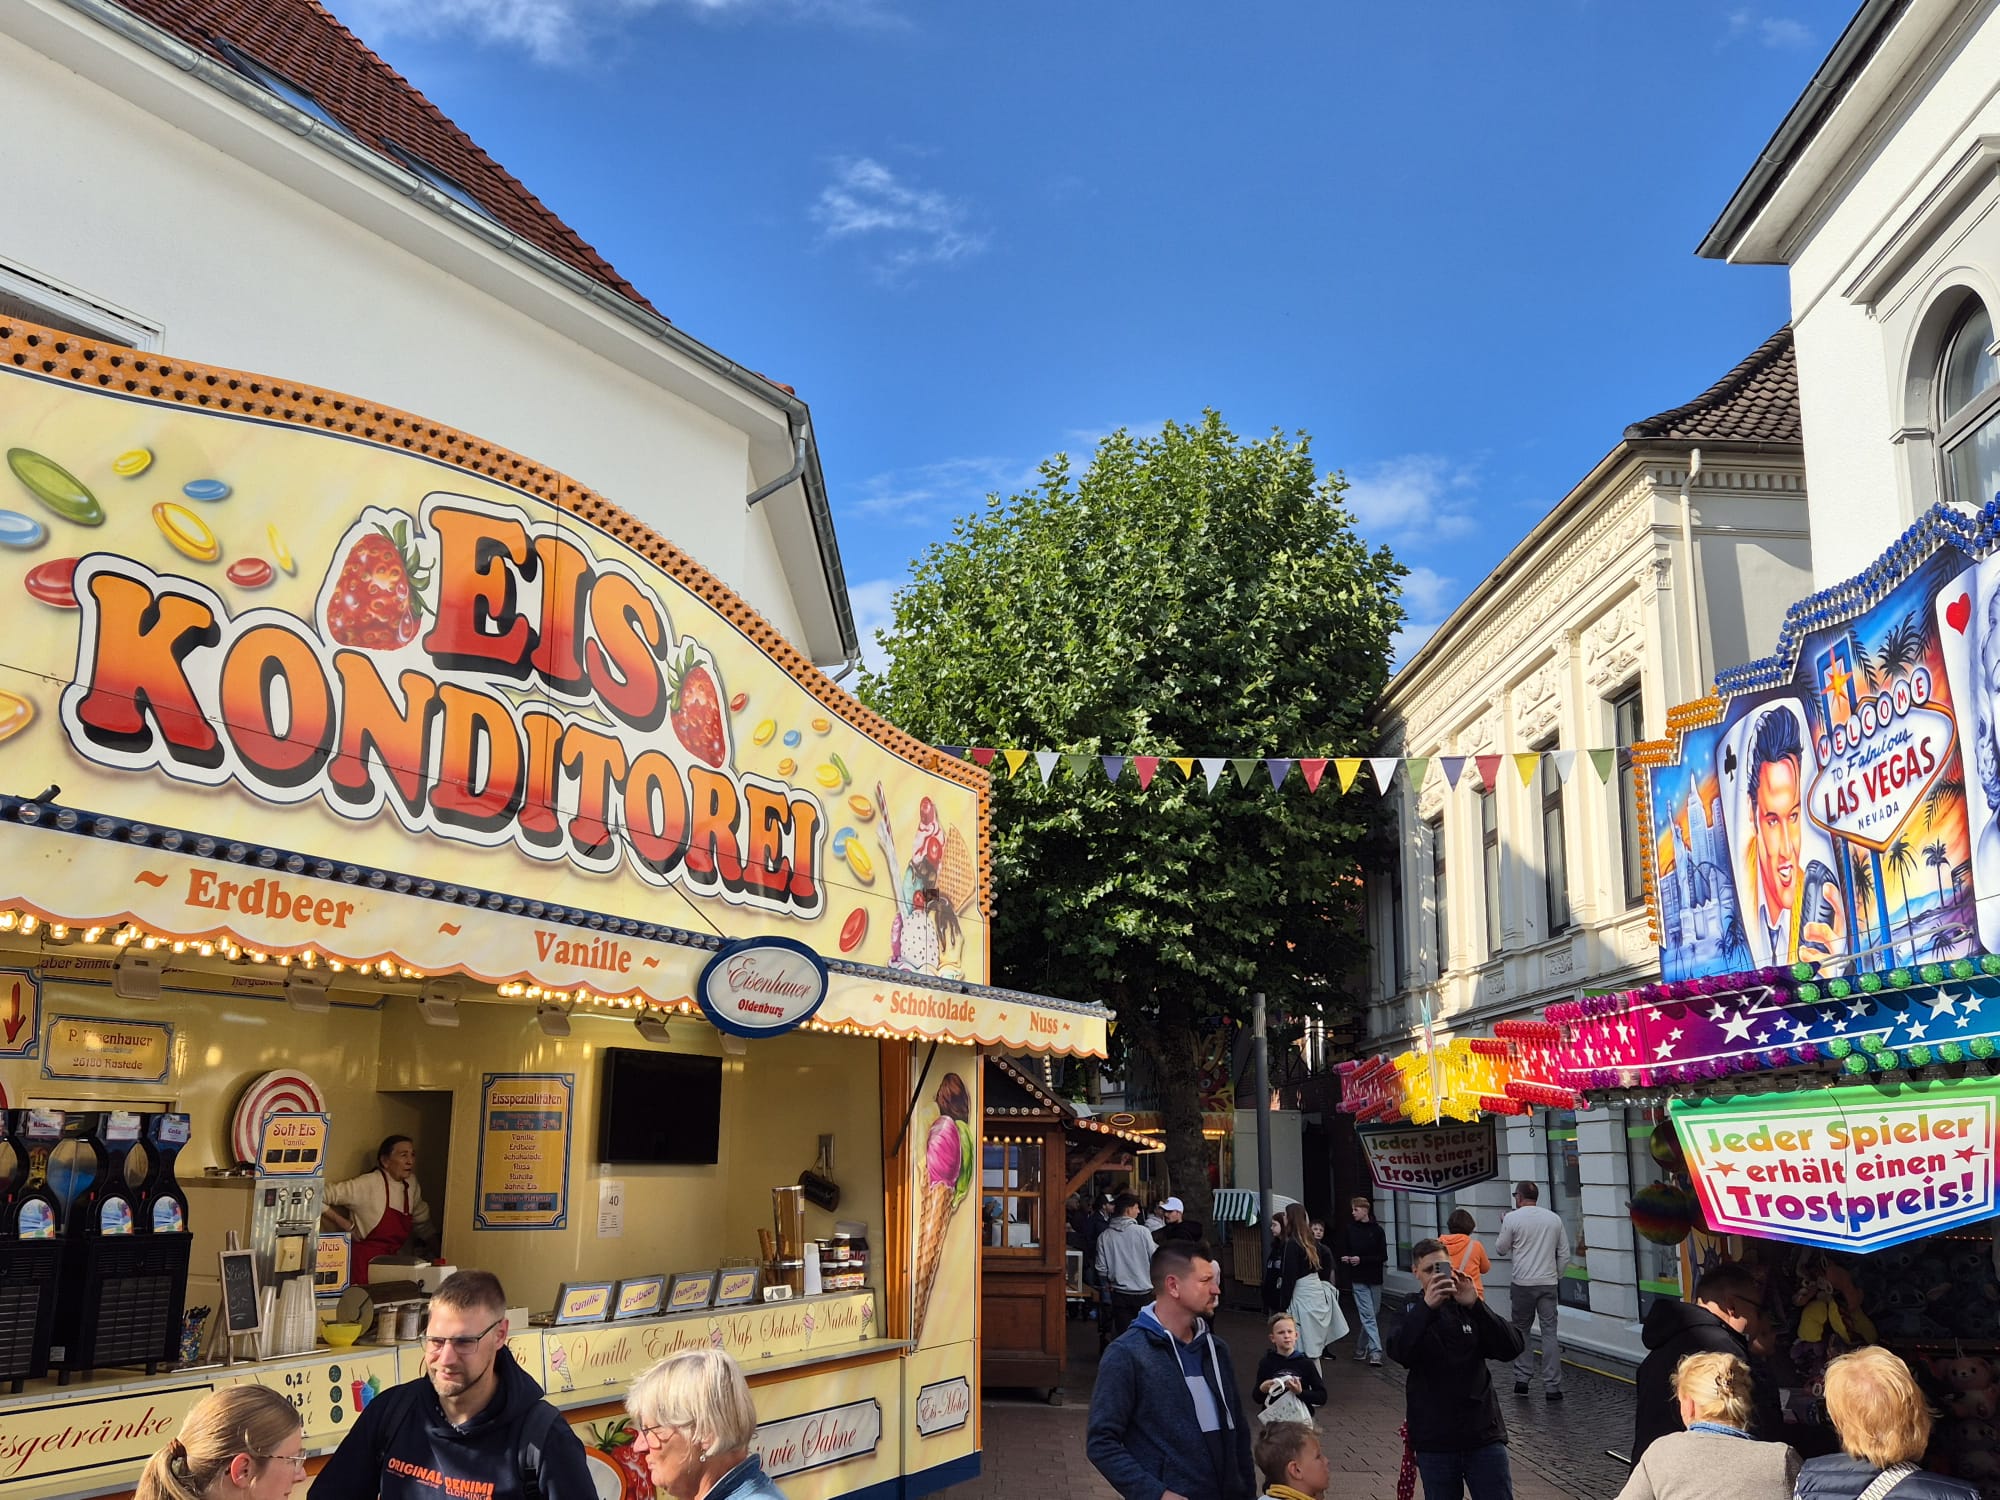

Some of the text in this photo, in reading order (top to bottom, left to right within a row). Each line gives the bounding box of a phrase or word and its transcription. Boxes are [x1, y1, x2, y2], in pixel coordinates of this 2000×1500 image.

[422, 504, 668, 732] EIS
[1820, 676, 1924, 759] WELCOME
[76, 571, 819, 907] KONDITOREI
[1831, 728, 1913, 782] TO Fabulous
[1825, 736, 1935, 824] LAS VEGAS
[1858, 801, 1900, 830] NEVADA
[184, 868, 354, 929] Erdbeer
[534, 930, 632, 973] Vanille
[726, 955, 812, 999] Eisenhauer
[738, 998, 785, 1018] Oldenburg
[890, 990, 976, 1023] Schokolade
[84, 1029, 153, 1047] enhauer
[1029, 1011, 1059, 1035] Nuss
[491, 1092, 562, 1107] Eisspezialitäten
[509, 1143, 536, 1151] Erdbeer
[1372, 1129, 1486, 1151] Jeder Spieler
[1707, 1113, 1974, 1155] Jeder Spieler
[1389, 1147, 1473, 1164] erhält einen
[1746, 1153, 1946, 1184] erhält einen
[1380, 1157, 1485, 1187] Trostpreis!
[608, 1195, 619, 1206] 40
[1726, 1171, 1974, 1233] Trostpreis!
[317, 1241, 340, 1252] ofteis
[570, 1293, 601, 1313] Vanille
[624, 1284, 657, 1309] Erdbeer
[571, 1302, 859, 1372] Vanille Erdbeere Nuß Schoko Nutella
[285, 1372, 303, 1389] 0,2
[286, 1392, 304, 1409] 0,3
[0, 1406, 173, 1477] isgetränke
[768, 1438, 796, 1468] wie
[801, 1412, 857, 1466] Sahne
[388, 1457, 443, 1485] ORIGINAL
